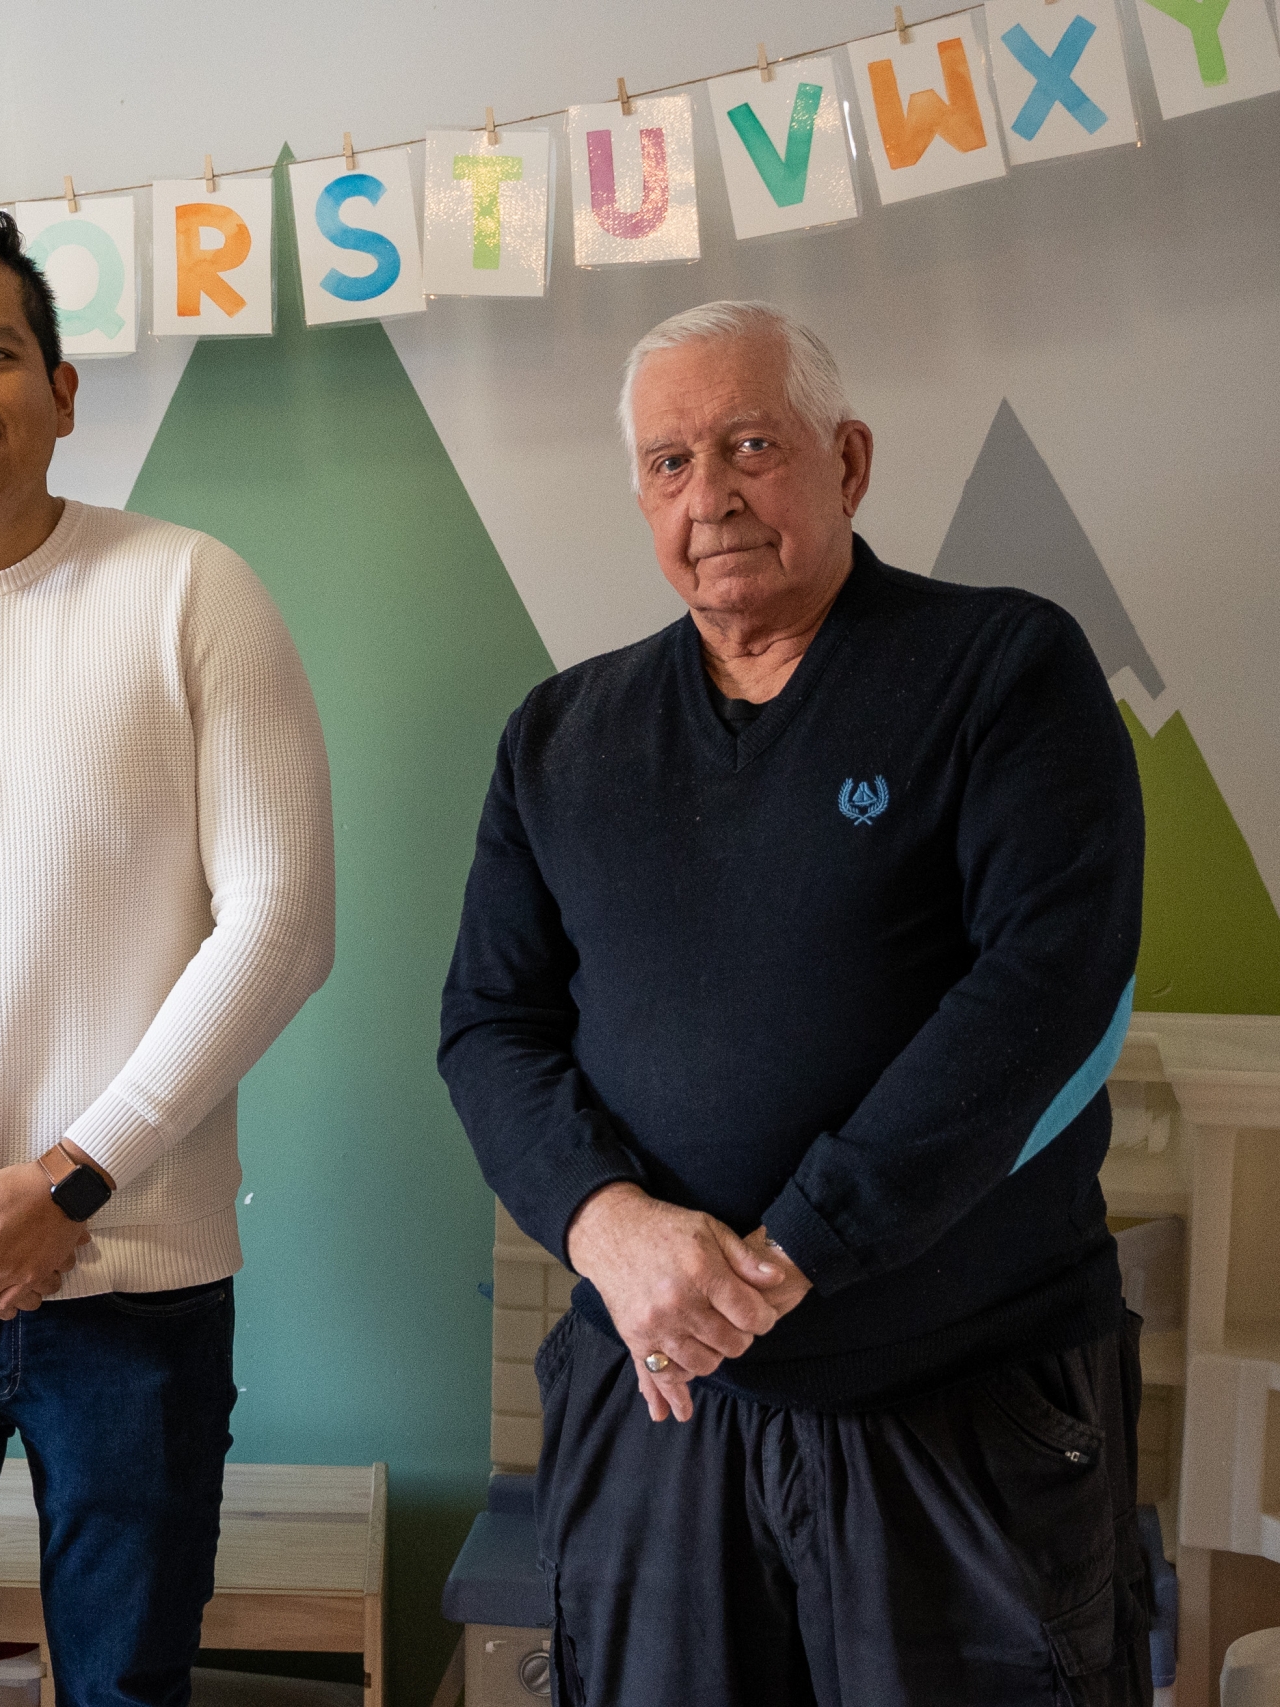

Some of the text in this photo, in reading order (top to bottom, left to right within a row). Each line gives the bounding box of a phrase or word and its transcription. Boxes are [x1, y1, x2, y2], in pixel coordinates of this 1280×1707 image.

[26, 219, 126, 340] Q
[175, 202, 252, 318] R
[314, 173, 401, 302] S
[452, 154, 523, 270] T
[586, 127, 669, 240] U
[726, 82, 823, 208] V
[867, 37, 988, 170] W
[1000, 14, 1109, 142] X
[1144, 0, 1230, 88] Y
